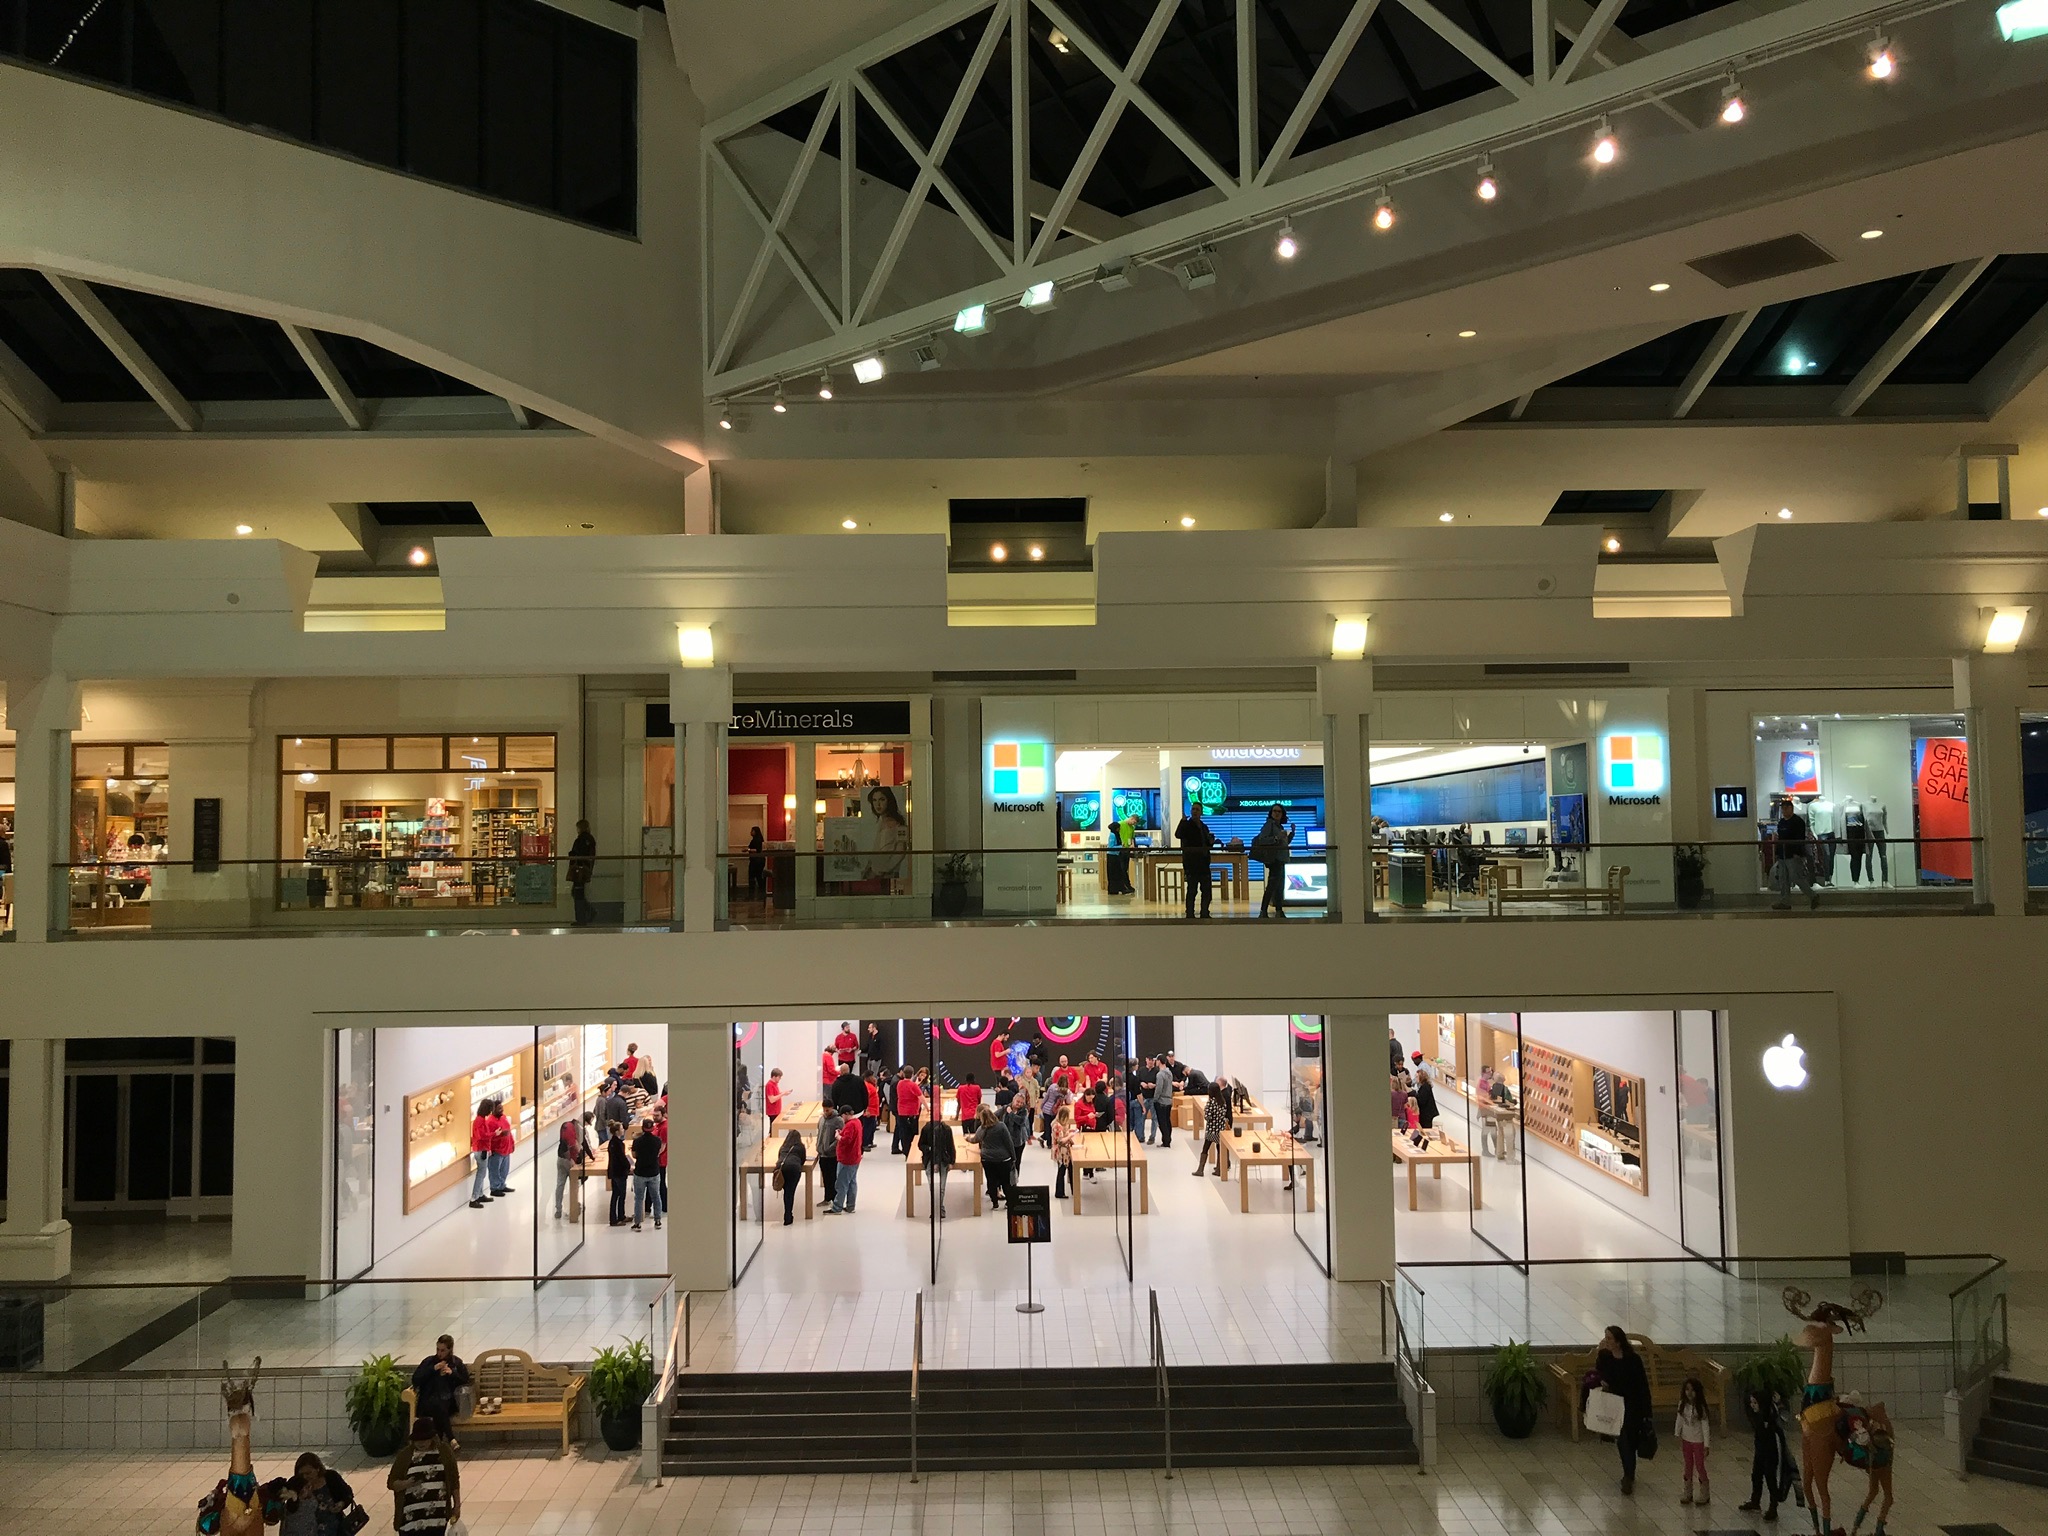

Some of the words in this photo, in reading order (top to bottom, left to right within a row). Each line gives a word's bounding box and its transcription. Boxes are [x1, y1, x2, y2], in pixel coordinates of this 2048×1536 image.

[728, 710, 853, 729] reMinerals
[1202, 789, 1222, 798] 100
[1609, 795, 1660, 805] Microsoft
[1721, 793, 1743, 811] GAP
[994, 801, 1045, 812] Microsoft
